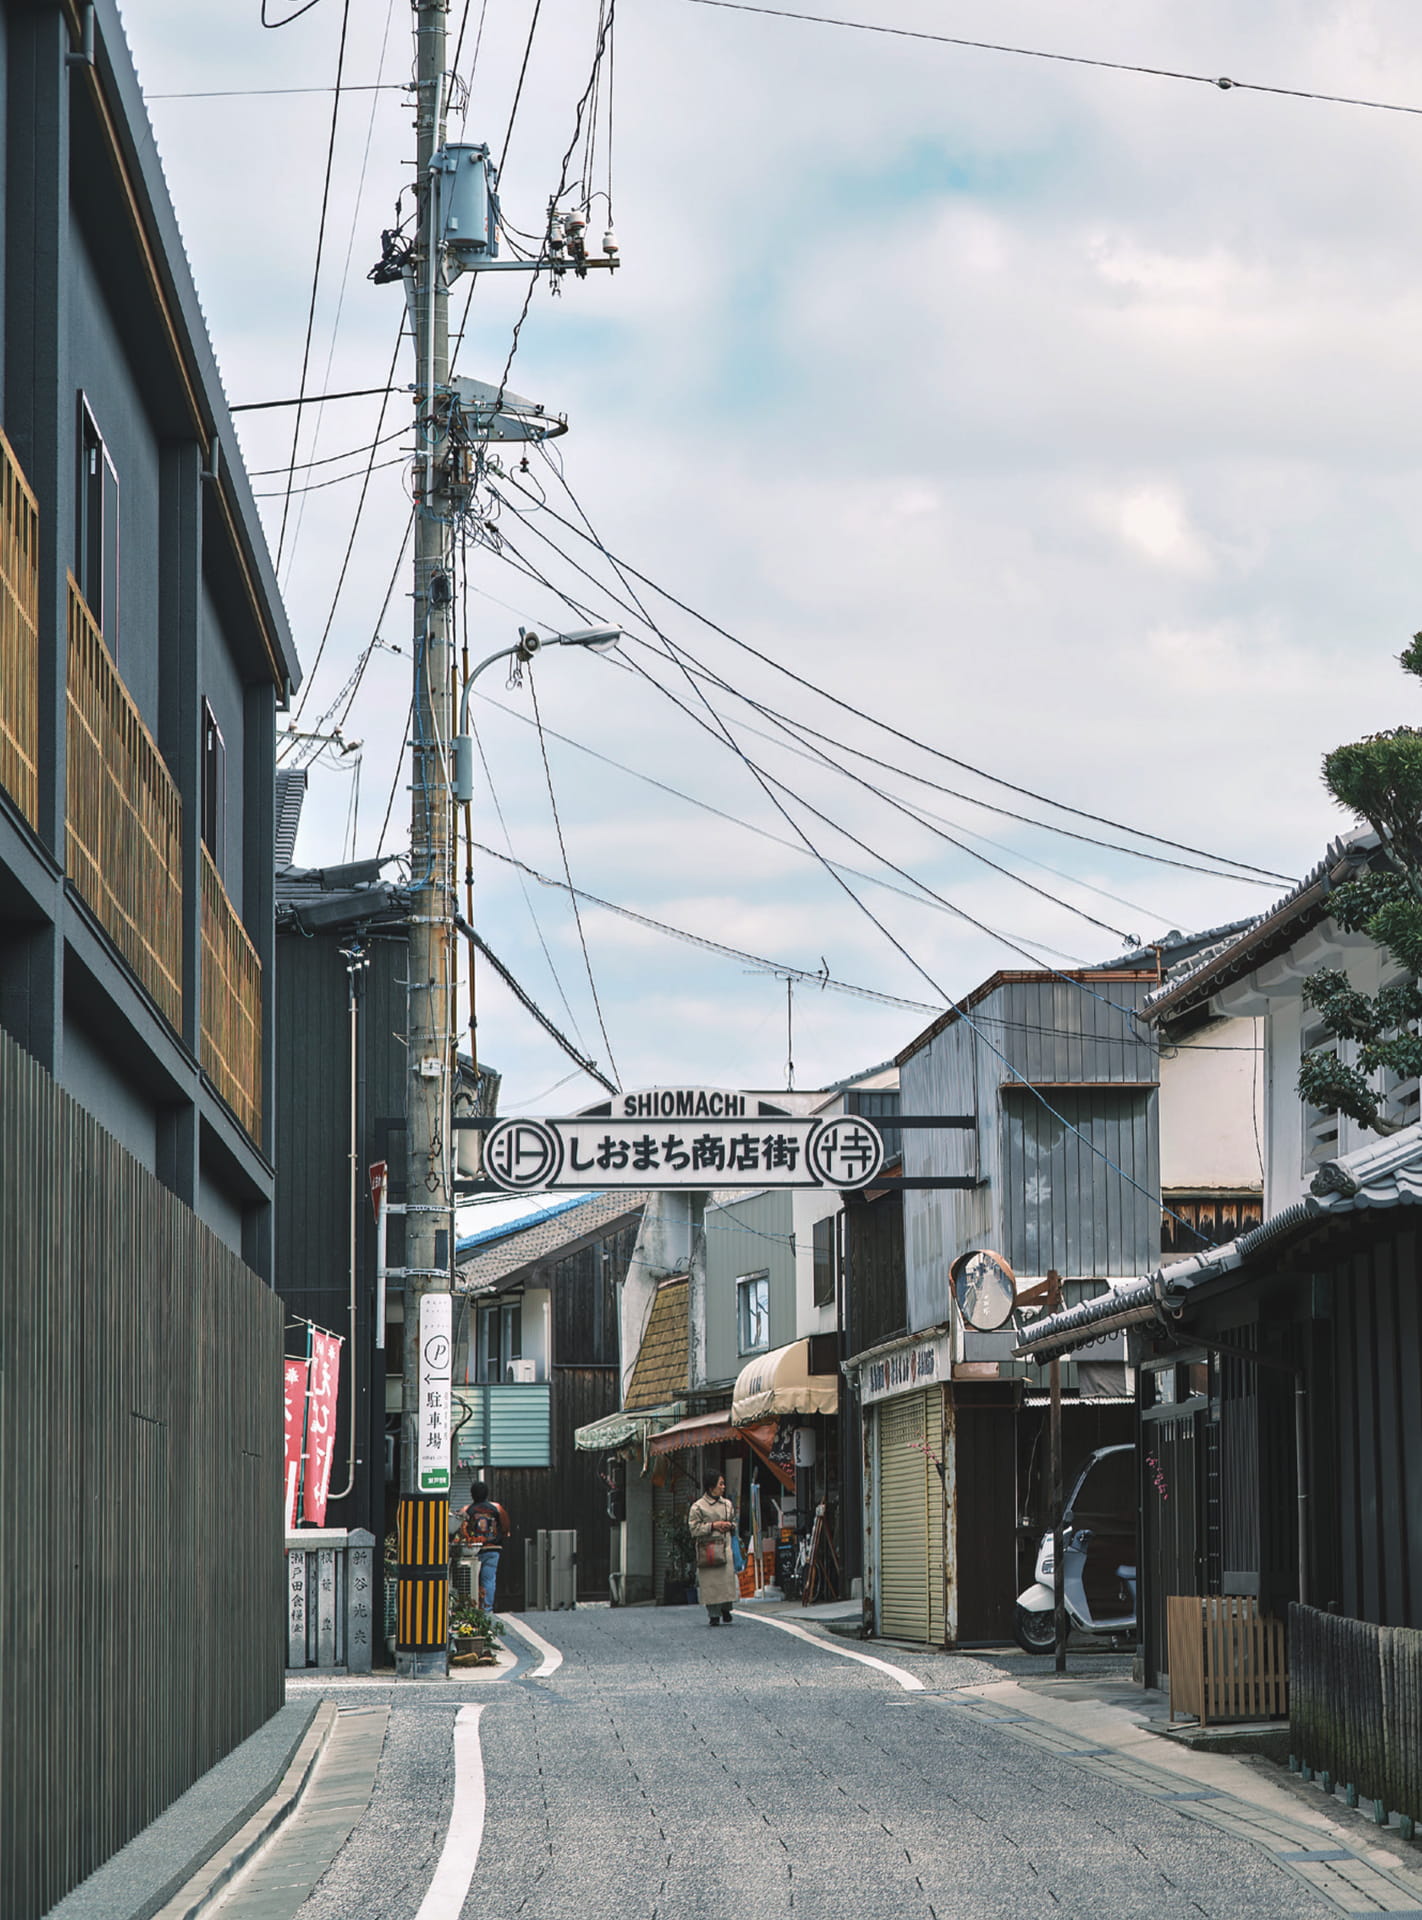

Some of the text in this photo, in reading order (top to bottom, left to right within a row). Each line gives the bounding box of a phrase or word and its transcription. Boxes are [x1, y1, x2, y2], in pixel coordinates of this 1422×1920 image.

[624, 1090, 746, 1117] SHIOMACHI
[569, 1133, 800, 1172] しおまち商店街
[820, 1127, 872, 1179] 待
[434, 1344, 447, 1361] P
[425, 1391, 442, 1450] 駐車場
